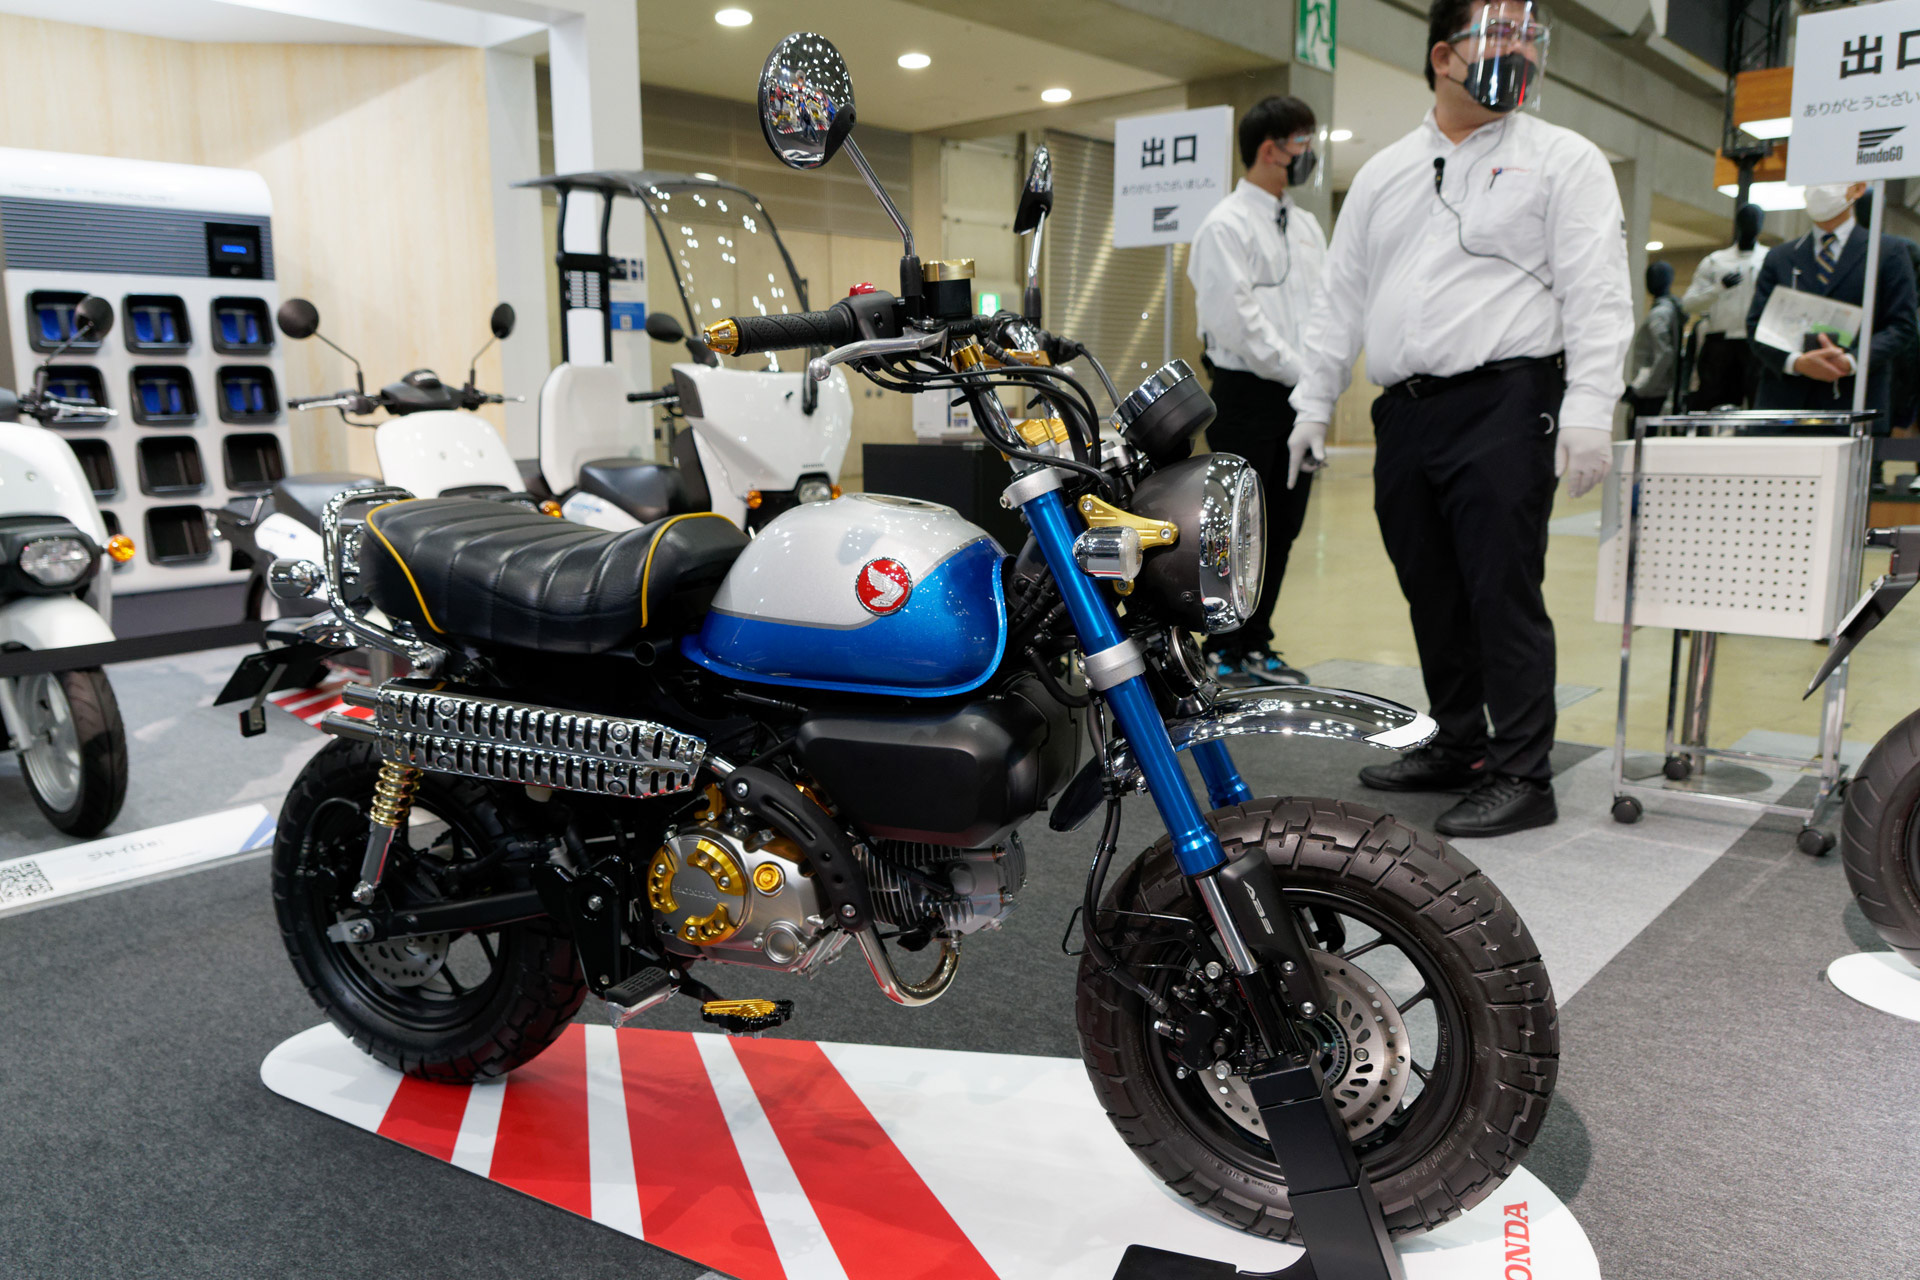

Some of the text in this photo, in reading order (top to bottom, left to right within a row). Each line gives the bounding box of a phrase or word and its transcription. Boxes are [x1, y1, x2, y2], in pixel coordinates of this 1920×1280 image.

[1141, 134, 1198, 170] 出口
[1855, 145, 1904, 166] HondaGO
[1242, 880, 1275, 935] ABS
[1504, 1200, 1533, 1280] ONDA
